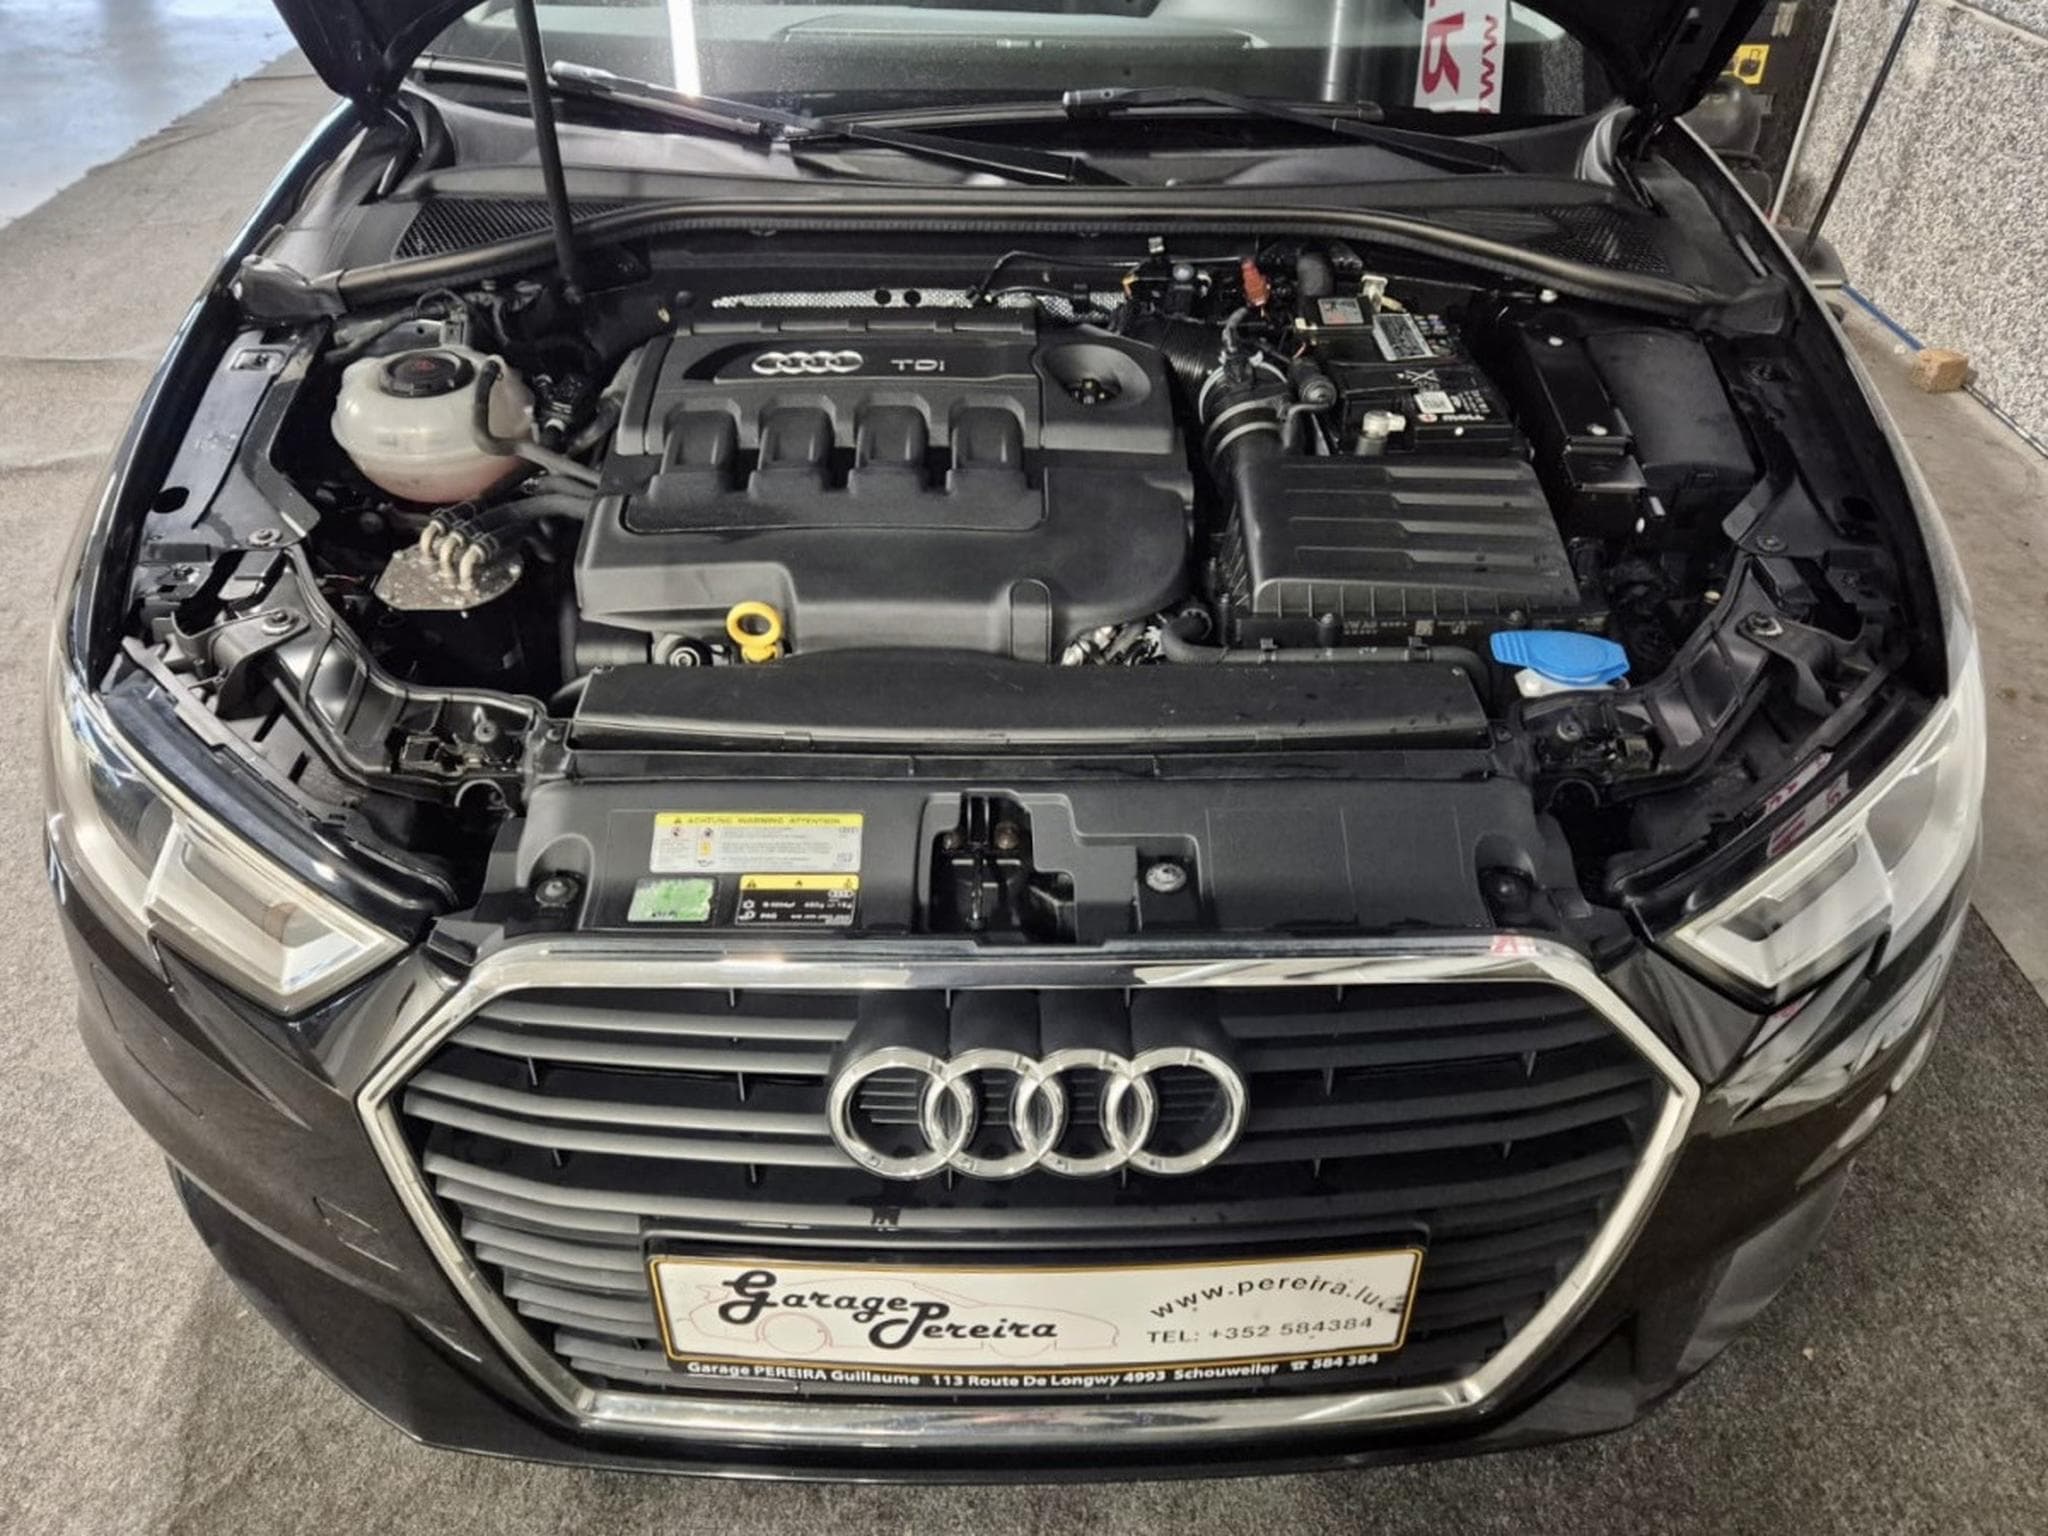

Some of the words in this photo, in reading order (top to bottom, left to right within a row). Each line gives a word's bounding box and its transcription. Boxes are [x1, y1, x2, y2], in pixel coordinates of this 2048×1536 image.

[890, 358, 945, 372] TDI
[718, 1270, 909, 1325] Garage
[868, 1302, 1058, 1349] Pereira
[1150, 1275, 1381, 1318] www.pereira.lu
[1147, 1329, 1199, 1345] TEL:
[1209, 1325, 1271, 1340] +352
[1279, 1317, 1374, 1336] 584384
[687, 1361, 751, 1378] Garage
[754, 1364, 827, 1381] PEREIRA
[830, 1369, 920, 1386] Guillaume
[932, 1375, 963, 1387] 113
[968, 1375, 1019, 1388] Route
[1023, 1376, 1047, 1387] De
[1051, 1375, 1120, 1389] Longwy
[1122, 1371, 1167, 1384] 4993
[1173, 1363, 1280, 1382] Schouweiler
[1311, 1355, 1343, 1370] 584
[1347, 1352, 1379, 1367] 384
